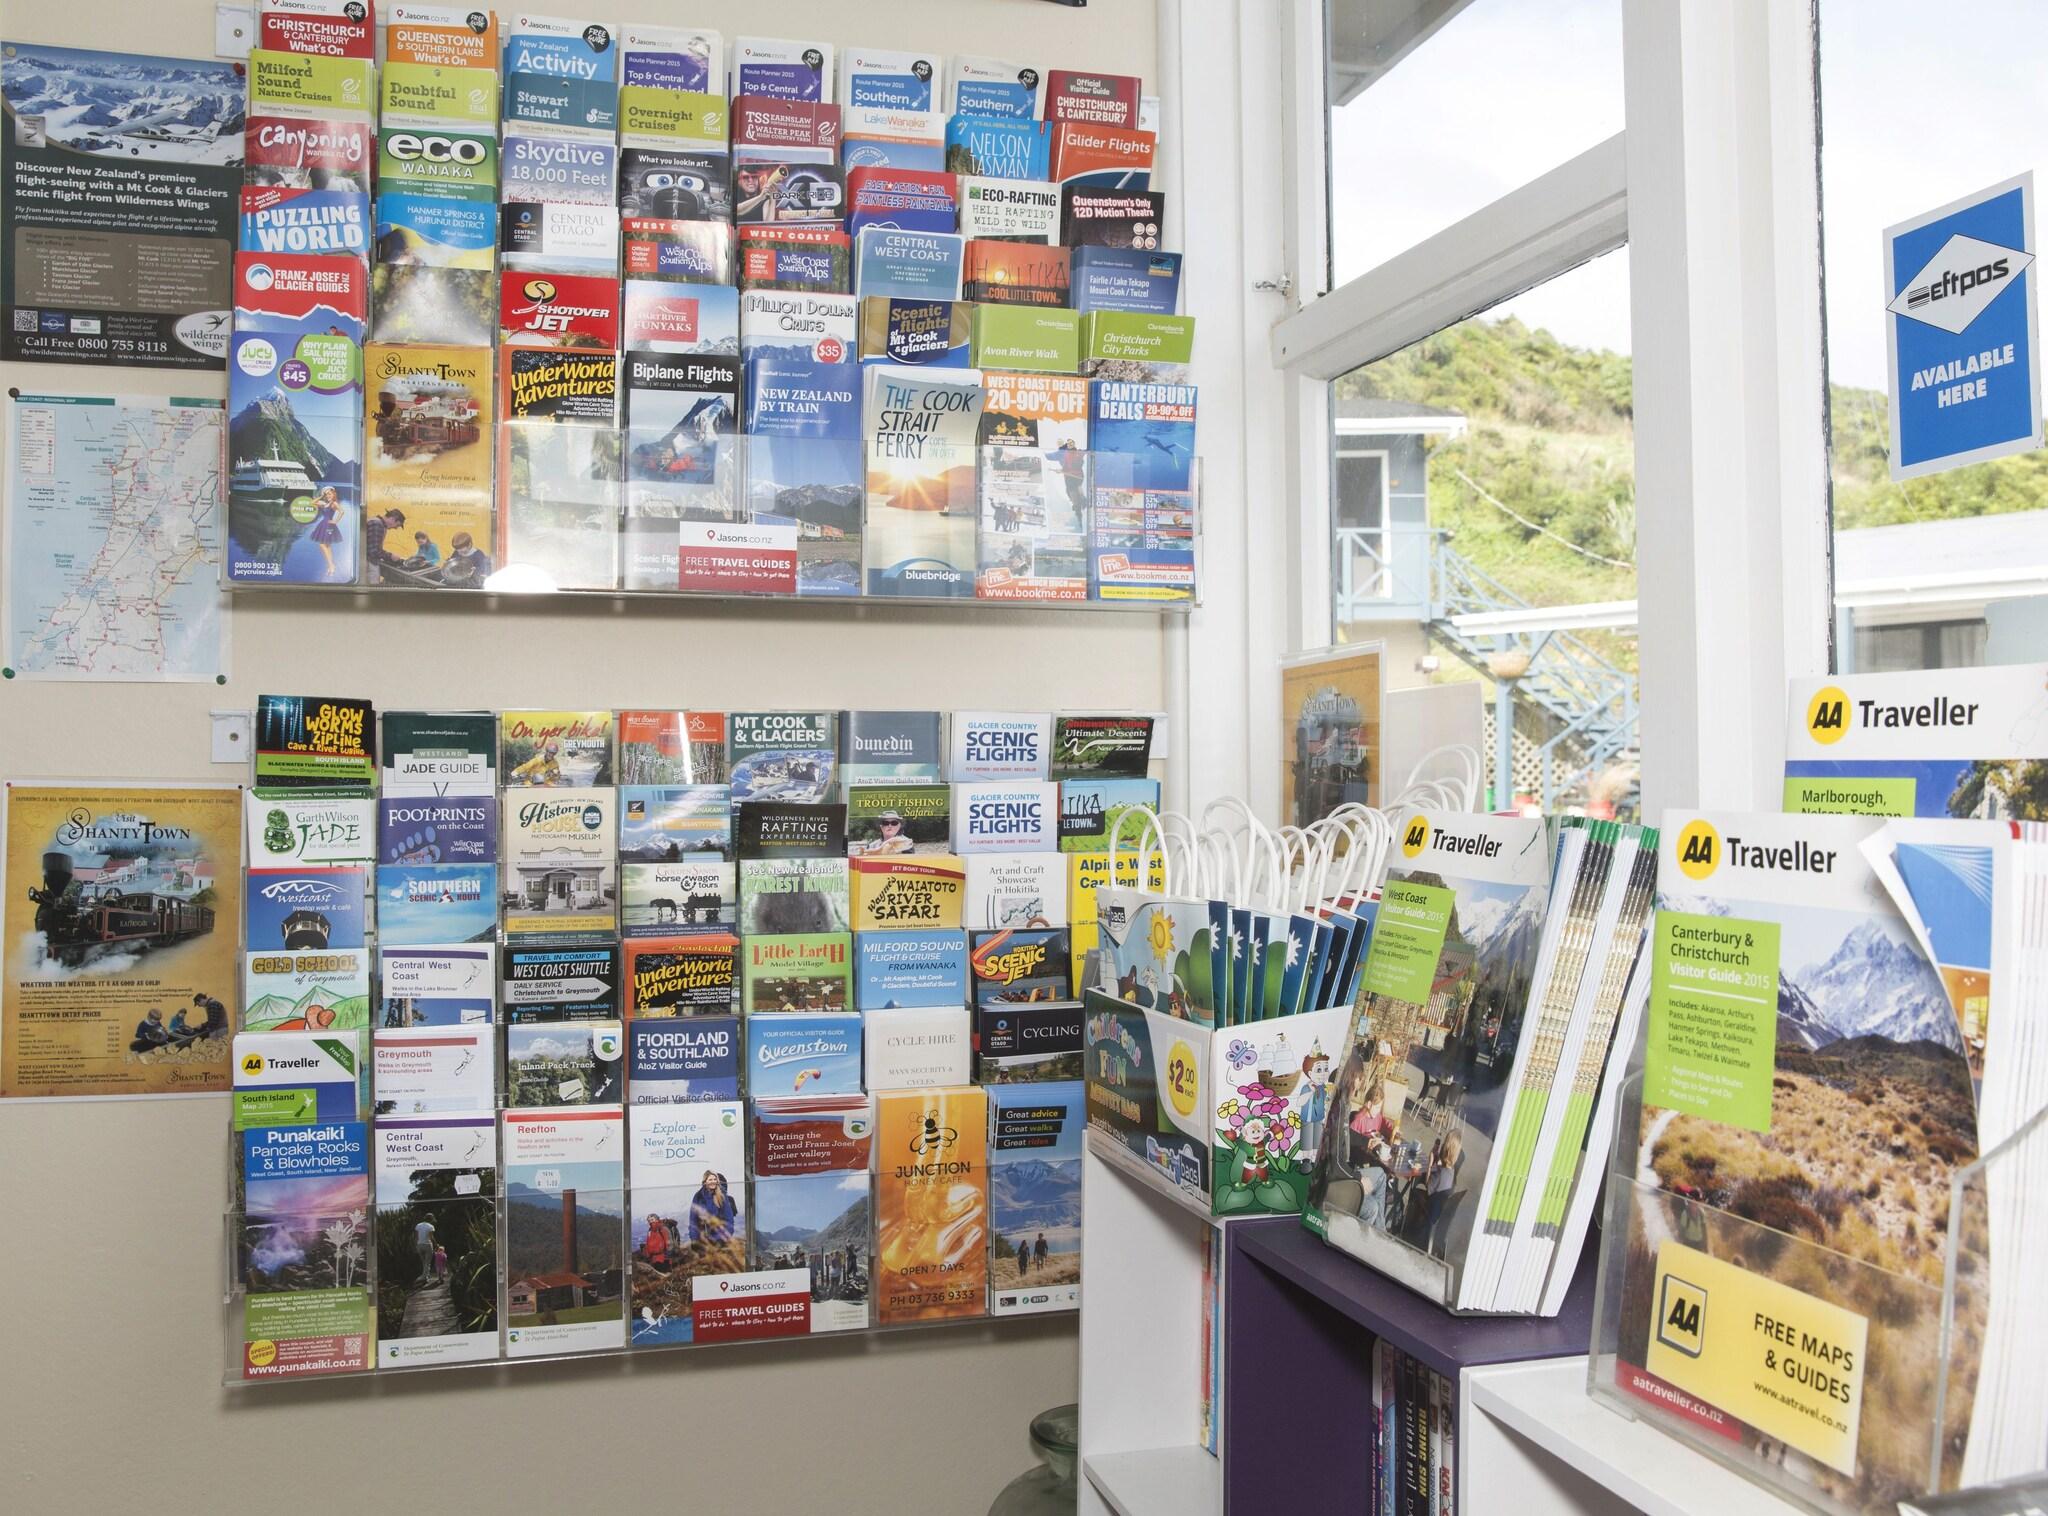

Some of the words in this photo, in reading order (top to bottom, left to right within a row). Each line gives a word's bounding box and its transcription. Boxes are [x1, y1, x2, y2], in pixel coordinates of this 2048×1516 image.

[267, 19, 365, 38] CHRISTCHURCH
[283, 30, 290, 39] &
[291, 31, 349, 45] CANTERBURY
[397, 31, 484, 48] QUEENSTOWN
[405, 43, 452, 55] SOUTHERN
[455, 46, 484, 57] LAKES
[257, 62, 313, 78] Milford
[517, 50, 597, 78] Activity
[258, 75, 301, 89] Sound
[1057, 96, 1128, 112] CHRISTCHURCH
[1057, 108, 1066, 119] &
[1071, 108, 1127, 123] CANTERBURY
[387, 134, 486, 163] eco
[1066, 132, 1103, 149] Glider
[1108, 137, 1151, 154] Flights
[516, 140, 605, 167] skydive
[16, 162, 64, 174] Discover
[67, 166, 91, 175] New
[95, 168, 145, 179] Zealand's
[149, 173, 196, 184] premiere
[401, 163, 474, 179] WANAKA
[511, 166, 567, 184] 18,000
[572, 171, 607, 185] Feet
[982, 188, 1057, 207] ECO-RAFTING
[257, 205, 359, 228] PUZZLING
[258, 225, 361, 252] WORLD
[886, 236, 940, 251] CENTRAL
[875, 248, 906, 259] WEST
[909, 250, 950, 262] COAST
[275, 270, 306, 282] FRANZ
[310, 271, 340, 282] JOSEF
[1931, 258, 2009, 301] eftpos
[275, 281, 313, 291] GLACIER
[316, 283, 350, 293] GUIDES
[538, 306, 609, 317] SHOTOVER
[525, 315, 572, 331] JET
[25, 337, 47, 346] Call
[51, 339, 74, 348] Free
[78, 338, 108, 349] 0800
[112, 340, 134, 350] 755
[138, 341, 167, 352] 8118
[1103, 333, 1162, 346] Christchurch
[985, 346, 1007, 358] Avon
[1011, 347, 1035, 358] River
[1038, 347, 1059, 358] Walk
[1103, 344, 1123, 356] City
[1126, 345, 1149, 356] Parks
[634, 363, 685, 381] Biplane
[689, 365, 734, 383] Flights
[1912, 344, 2015, 391] AVAILABLE
[512, 361, 614, 392] UnderWorld
[987, 375, 1014, 390] WEST
[1017, 378, 1050, 391] COAST
[1053, 380, 1086, 392] DEALS!
[514, 379, 615, 407] Adventures
[760, 388, 784, 402] NEW
[789, 388, 852, 402] ZEALAND
[886, 385, 915, 410] THE
[923, 389, 975, 412] COOK
[988, 389, 1054, 411] 20-90%
[1058, 393, 1086, 413] OFF
[1101, 383, 1197, 404] CANTERBURY
[1938, 378, 1987, 408] HERE
[760, 400, 773, 413] BY
[777, 401, 819, 414] TRAIN
[1100, 401, 1143, 420] DEALS
[1146, 404, 1178, 417] 20-90%
[1179, 405, 1194, 417] OFF
[881, 411, 943, 433] STRAIT
[876, 432, 926, 460] FERRY
[716, 533, 773, 544] Jasons.co.nz
[685, 556, 708, 567] FREE
[711, 557, 747, 568] TRAVEL
[751, 558, 790, 569] GUIDES
[905, 569, 962, 582] bluebridge
[985, 587, 1086, 600] www.bookme.co.nz
[320, 704, 363, 720] GLOW
[1813, 701, 1843, 729] AA
[1859, 697, 1978, 728] Traveller
[306, 717, 363, 735] WORMS
[735, 717, 754, 729] MT
[763, 717, 806, 729] COOK
[968, 722, 1000, 730] GLACIER
[1002, 723, 1038, 731] COUNTRY
[736, 730, 747, 742] &
[753, 729, 825, 742] GLACIERS
[855, 734, 914, 753] dunedin
[967, 731, 1037, 748] SCENIC
[966, 746, 1037, 763] FLIGHTS
[402, 763, 436, 774] JADE
[440, 762, 479, 773] GUIDE
[1802, 790, 1886, 806] Marlborough,
[388, 808, 485, 827] FOOTPRINTS
[762, 820, 828, 833] RAFTING
[1405, 826, 1425, 847] AA
[1433, 829, 1502, 857] Traveller
[1683, 836, 1712, 863] AA
[1727, 837, 1836, 873] Traveller
[409, 880, 481, 893] SOUTHERN
[896, 880, 956, 893] WAIATOTO
[888, 892, 933, 905] RIVER
[1389, 889, 1403, 901] West
[1406, 892, 1427, 904] Coast
[875, 904, 940, 920] SAFARI
[1671, 925, 1742, 945] Canterbury
[1745, 934, 1754, 946] &
[863, 942, 918, 952] MILFORD
[920, 941, 964, 951] SOUND
[1671, 943, 1749, 966] Christchurch
[514, 964, 537, 976] WEST
[540, 964, 569, 976] COAST
[571, 962, 610, 975] SHUTTLE
[1670, 962, 1706, 980] Visitor
[1708, 965, 1741, 985] Guide
[1745, 970, 1769, 989] 2015
[637, 1032, 729, 1047] FIORDLAND
[1023, 1025, 1079, 1039] CYCLING
[378, 1050, 432, 1059] Greymouth
[638, 1049, 645, 1058] &
[649, 1046, 728, 1058] SOUTHLAND
[760, 1039, 848, 1063] Queenstown
[268, 1058, 320, 1069] Traveller
[267, 1093, 295, 1102] Island
[267, 1128, 344, 1143] Punakaiki
[386, 1133, 423, 1141] Central
[252, 1144, 317, 1157] Pancake
[321, 1142, 360, 1153] Rocks
[386, 1144, 413, 1153] West
[417, 1144, 444, 1152] Coast
[264, 1160, 273, 1168] &
[276, 1155, 349, 1168] Blowholes
[896, 1161, 970, 1178] JUNCTION
[730, 1281, 785, 1292] Jasons.co.nz
[699, 1308, 723, 1319] FREE
[725, 1305, 764, 1317] TRAVEL
[767, 1303, 805, 1315] GUIDES
[1668, 1298, 1700, 1336] AA
[1755, 1313, 1795, 1347] FREE
[1802, 1333, 1853, 1371] MAPS
[249, 1358, 361, 1374] www.punakaiki.co.nz
[1766, 1350, 1776, 1370] &
[1783, 1358, 1851, 1403] GUIDES
[1633, 1374, 1723, 1424] aatraveller.co.nz
[1754, 1381, 1847, 1434] www.aatravel.co.nz
